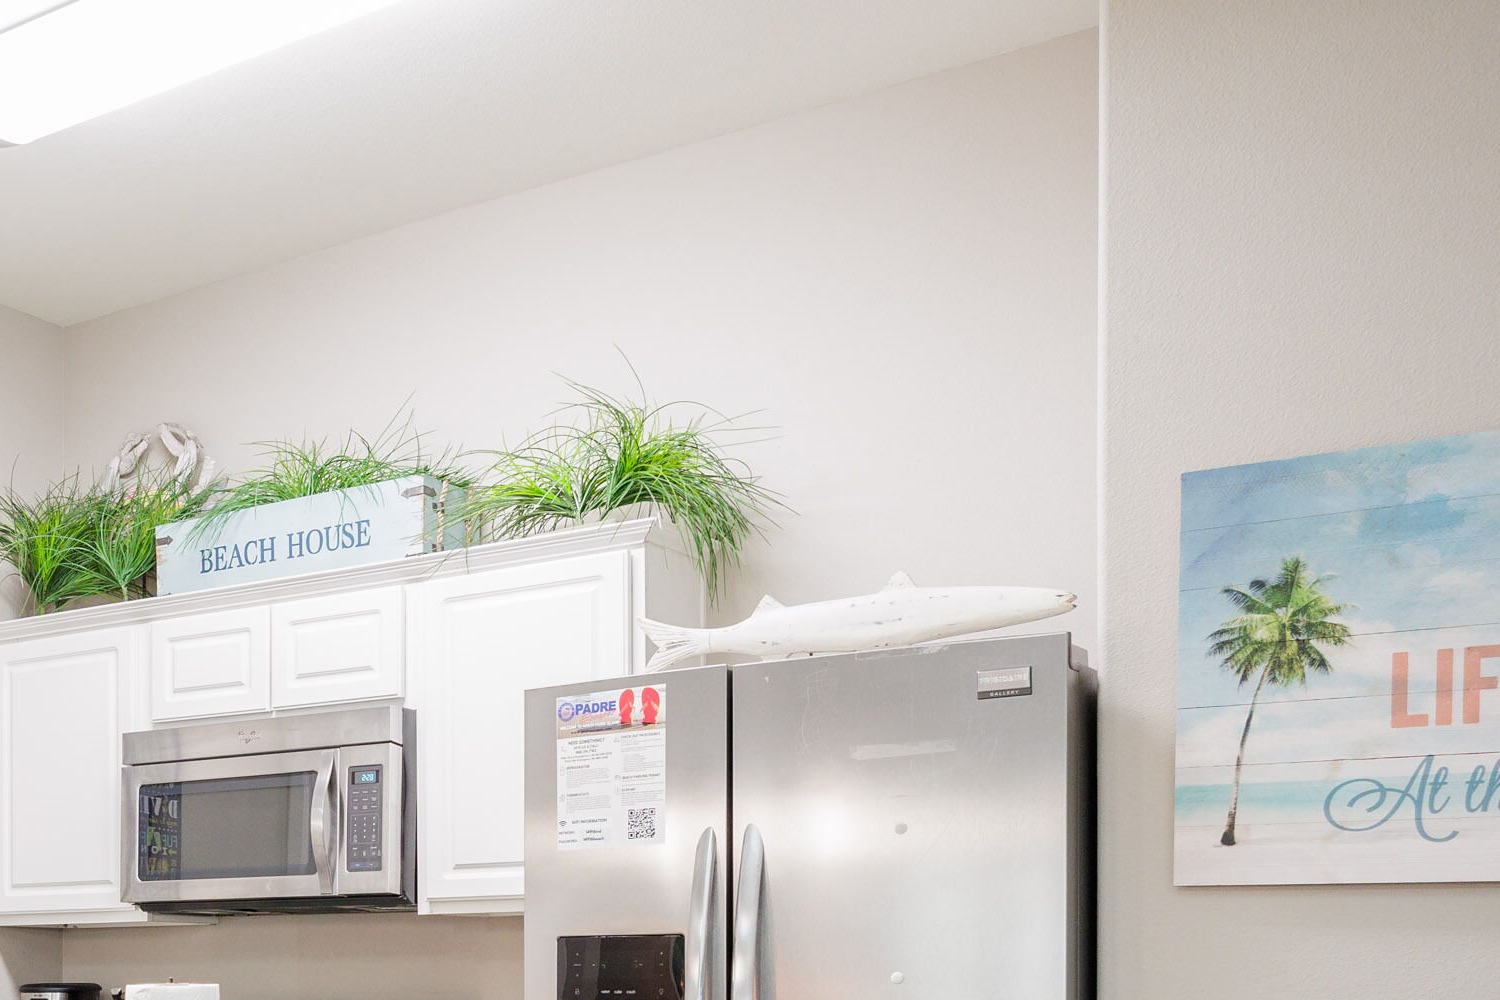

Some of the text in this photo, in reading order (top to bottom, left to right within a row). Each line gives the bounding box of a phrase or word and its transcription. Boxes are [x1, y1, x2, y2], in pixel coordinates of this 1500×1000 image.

[200, 519, 371, 573] BEACH HOUSE
[575, 700, 617, 716] PADRE
[989, 689, 1019, 697] GALLERY
[1391, 644, 1500, 728] LIF
[1323, 754, 1460, 842] At
